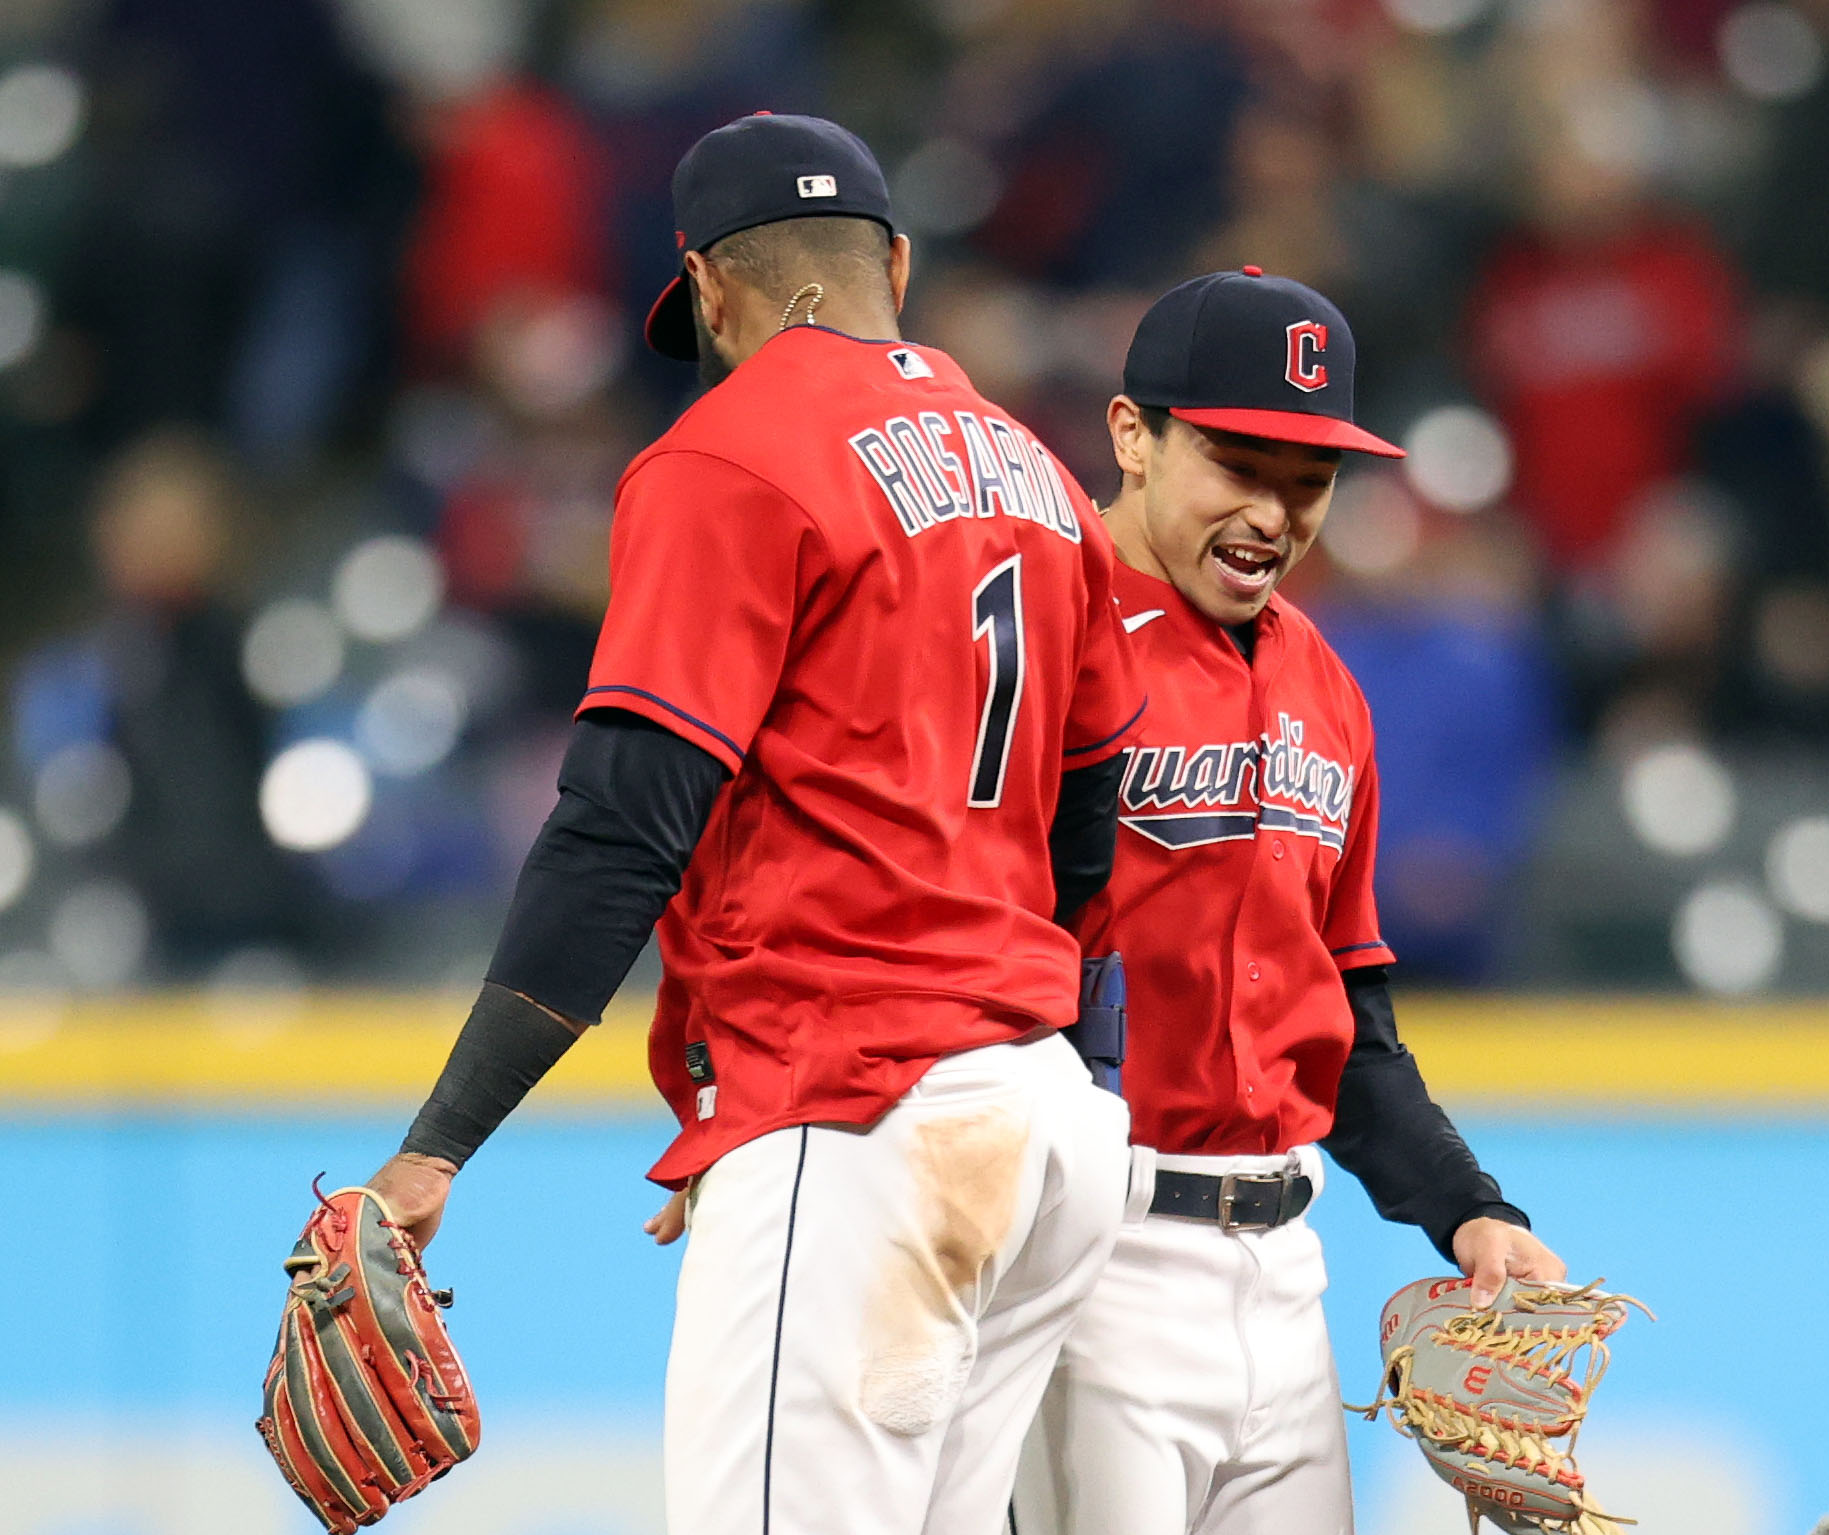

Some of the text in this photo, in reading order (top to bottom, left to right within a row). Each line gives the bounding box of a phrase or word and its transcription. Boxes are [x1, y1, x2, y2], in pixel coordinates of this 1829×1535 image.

[1285, 320, 1328, 392] C
[848, 410, 1082, 544] ROSARIO
[967, 553, 1025, 808] 1
